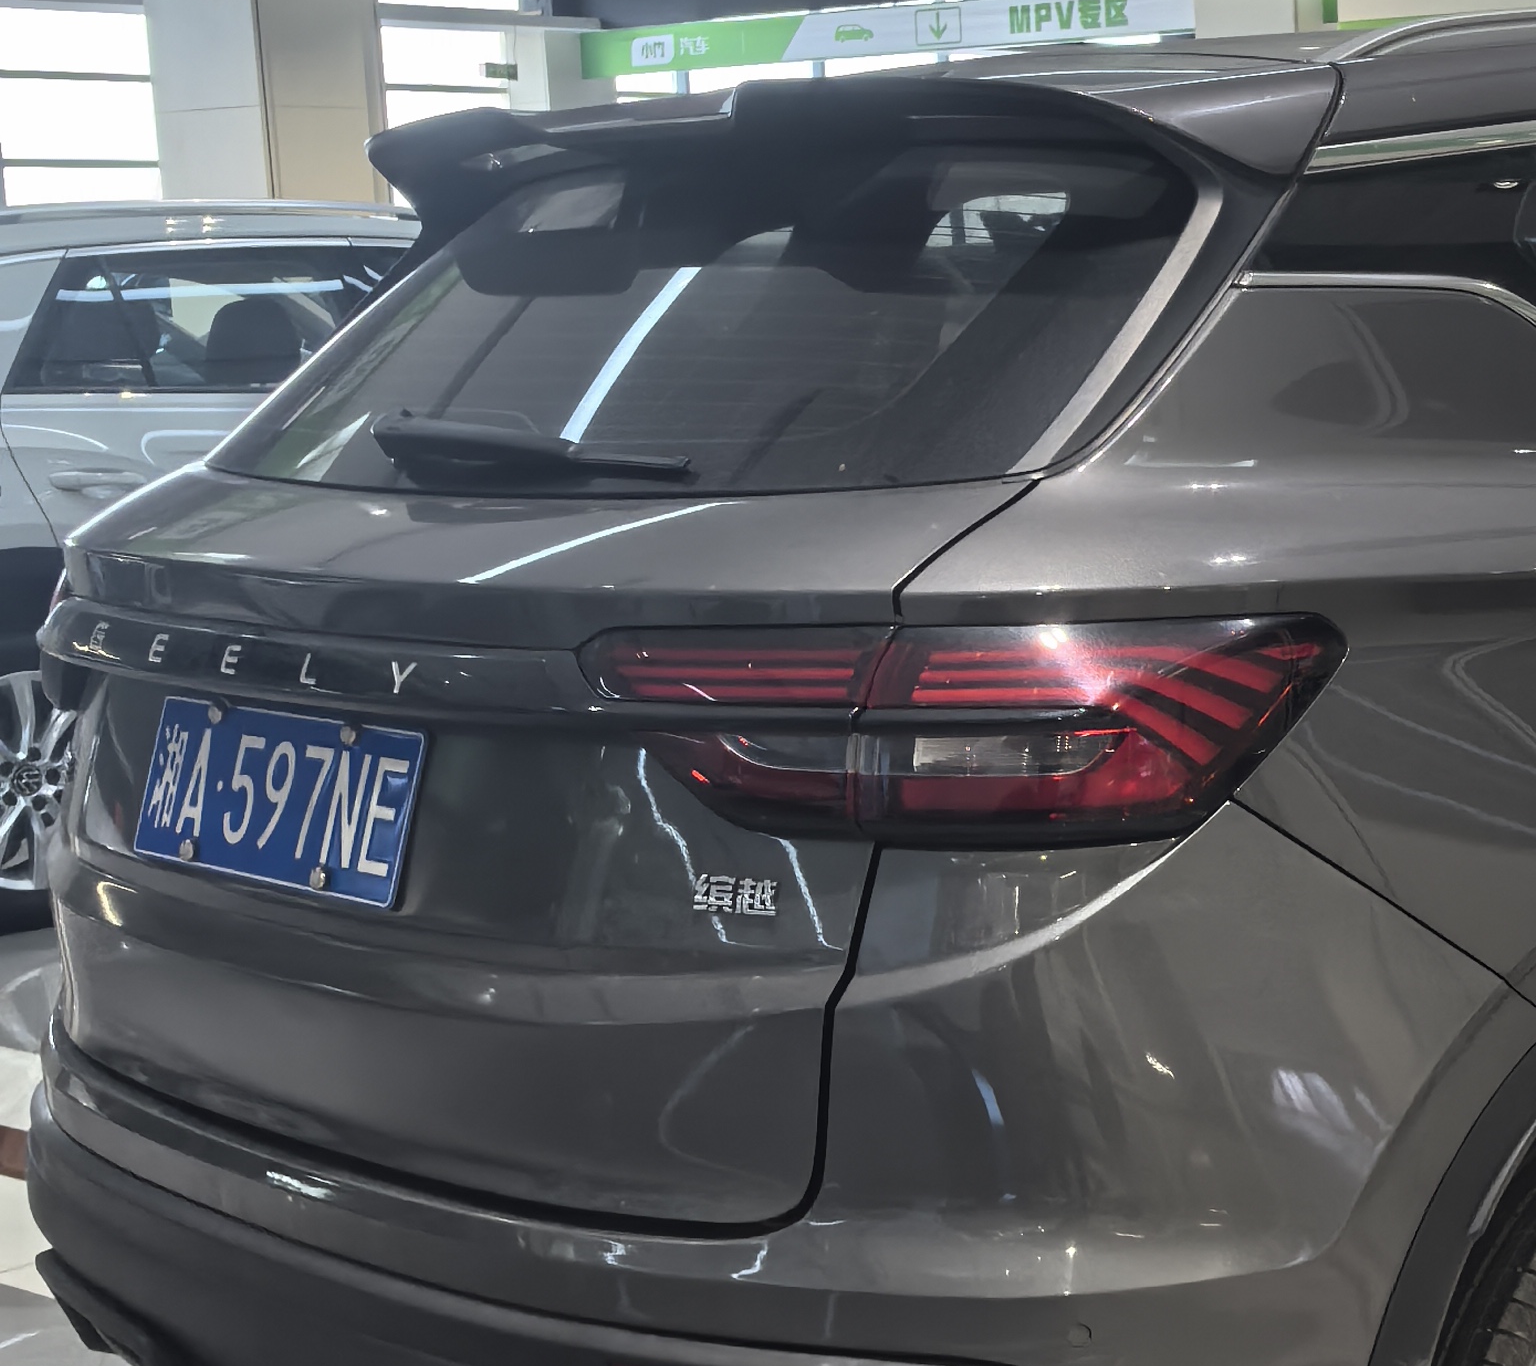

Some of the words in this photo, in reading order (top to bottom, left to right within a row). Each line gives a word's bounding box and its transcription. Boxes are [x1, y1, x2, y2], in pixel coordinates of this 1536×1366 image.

[679, 36, 710, 56] 汽车
[89, 619, 417, 695] GEELY
[693, 873, 778, 917] 缤越
